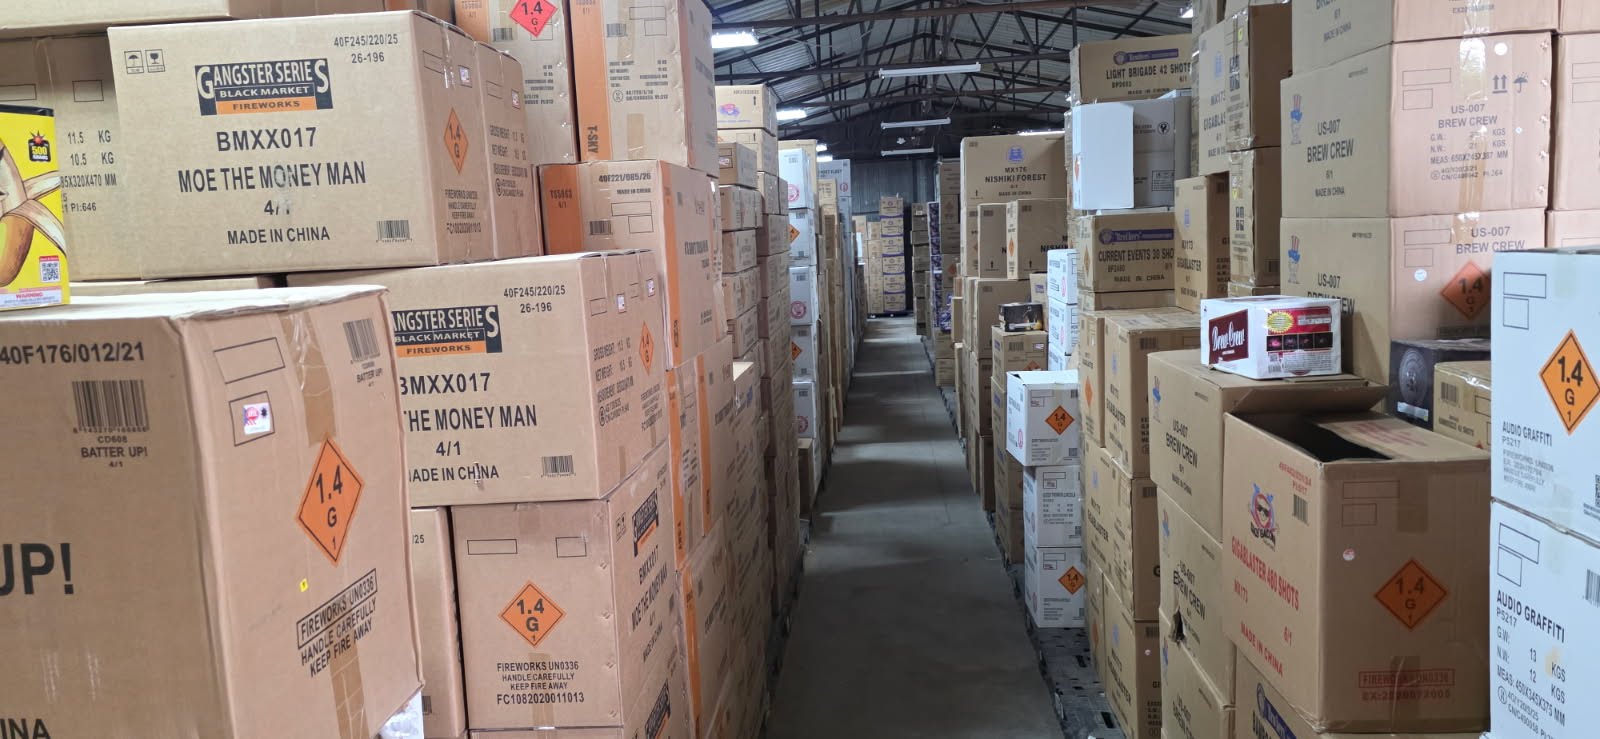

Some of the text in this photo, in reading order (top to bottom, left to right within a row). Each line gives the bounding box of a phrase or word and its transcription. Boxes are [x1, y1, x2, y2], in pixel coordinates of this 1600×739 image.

[521, 2, 543, 16] 1.4
[531, 18, 538, 26] G
[334, 34, 398, 47] 40F245/220/25
[351, 52, 385, 63] 26-196
[197, 59, 328, 99] GANGSTER SERIES
[1106, 69, 1125, 79] LIGHT
[1129, 66, 1156, 77] BRIGADE
[1160, 65, 1167, 73] 42
[220, 86, 309, 98] BLACK MARKET
[233, 100, 300, 110] FIREWORKS
[1451, 104, 1485, 114] US-007
[1317, 119, 1341, 136] US-007
[1438, 115, 1498, 128] BREW CREW
[68, 130, 111, 145] 11.5 KG
[216, 127, 316, 151] BMXX017
[587, 126, 598, 153] T-SKY
[32, 146, 47, 155] 500
[1307, 139, 1354, 163] BREW CREW
[70, 152, 115, 166] 10.5 KG
[104, 173, 117, 186] MM
[178, 161, 366, 192] MOE THE MONEY MAN
[985, 173, 1047, 183] NISHIKI FOREST
[227, 226, 330, 244] MADE IN CHINA
[1471, 227, 1511, 237] US-007
[1457, 240, 1524, 254] BREW CREW
[1098, 250, 1125, 262] CURRENT
[1128, 249, 1150, 261] EVENTS
[1162, 248, 1174, 259] SHO
[1317, 273, 1341, 287] US-007
[1459, 278, 1483, 294] 1.4
[504, 285, 565, 298] 40F245/220/25
[520, 302, 552, 313] 26-196
[450, 306, 499, 337] SERIES
[395, 331, 480, 343] BLACK MARKET
[0, 342, 144, 365] 40F176/012/21
[406, 344, 471, 355] FIREWORKS
[357, 371, 374, 383] BATTER
[1557, 356, 1583, 387] 1.4
[1565, 388, 1575, 406] G
[403, 404, 537, 431] HE MONEY MAN
[1567, 411, 1572, 422] 1
[1503, 421, 1552, 447] AUDIO GRAFFITI
[81, 446, 148, 458] BATTER UP!
[436, 442, 461, 457] 4/1
[1166, 432, 1198, 468] BREW CREW
[409, 464, 499, 482] ADE IN CHINA
[316, 464, 343, 504] 1.4
[327, 507, 337, 527] G
[332, 536, 336, 550] 1
[1231, 536, 1299, 611] GIGABLASTER SHOTS
[1395, 577, 1424, 595] 1.4
[301, 575, 374, 641] FIREWORKS UN0336
[517, 598, 544, 615] 1.4
[1405, 599, 1416, 609] G
[1497, 590, 1565, 643] AUDIO GRAFFITI
[301, 598, 377, 666] HANDLE CAREFULLY
[526, 617, 539, 632] G
[310, 618, 373, 677] KEEP FIRE AWAY
[1241, 621, 1283, 678] MADE IN CHINA
[497, 661, 579, 672] FIREWORKS UN0336
[1530, 648, 1566, 682] 13 KGS
[502, 673, 575, 682] HANDLE CAREFULLY
[531, 682, 547, 690] FIRE
[1529, 669, 1565, 704] 12 KGS
[497, 692, 585, 705] FC1082020011013
[1554, 707, 1565, 727] MM
